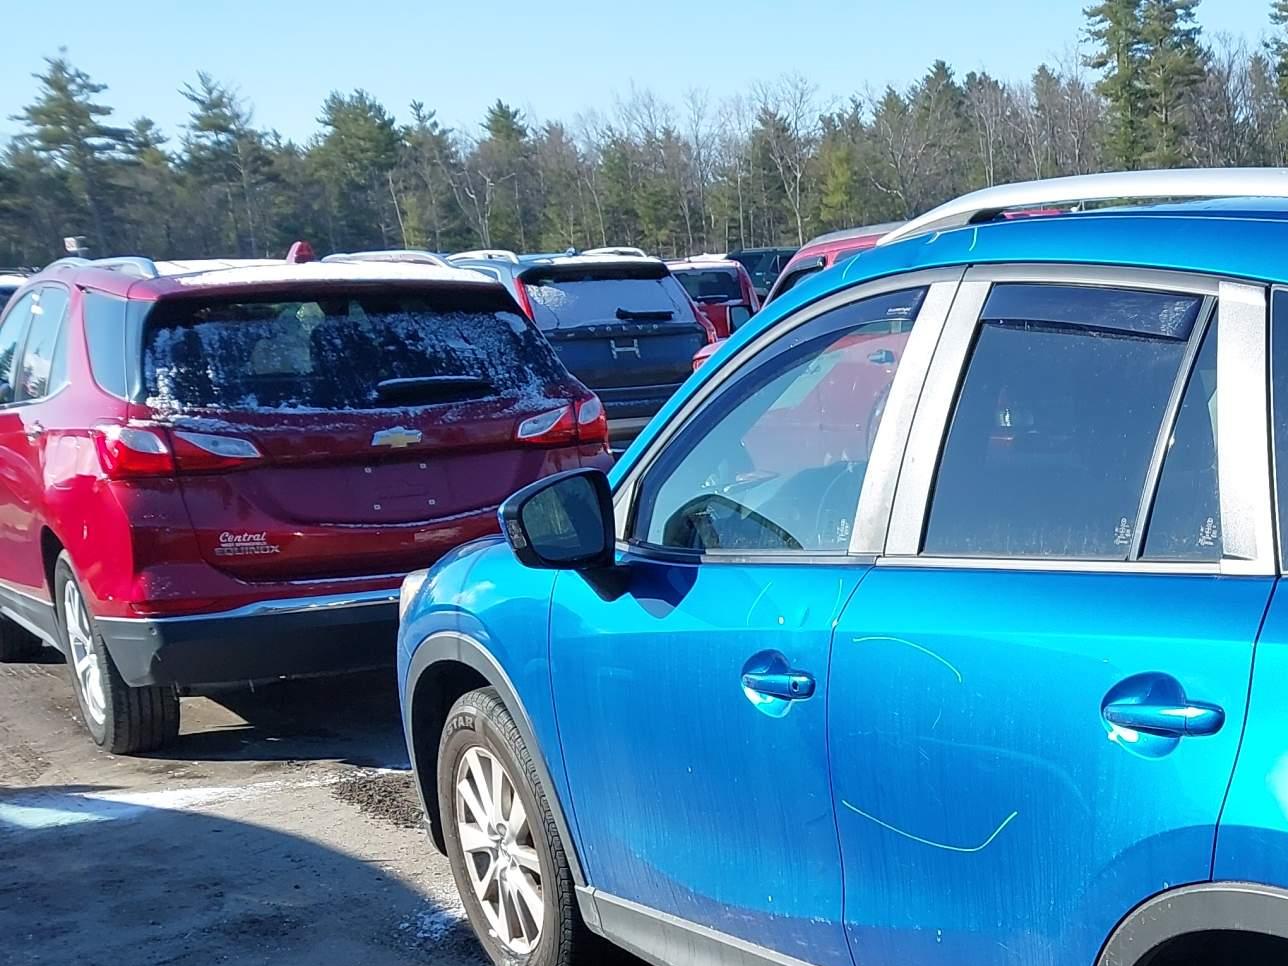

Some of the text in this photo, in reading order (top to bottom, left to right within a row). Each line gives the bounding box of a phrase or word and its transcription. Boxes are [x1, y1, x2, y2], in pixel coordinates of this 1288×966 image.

[588, 323, 659, 333] VOLVO
[219, 531, 267, 542] Central
[214, 545, 280, 556] EQUINOX
